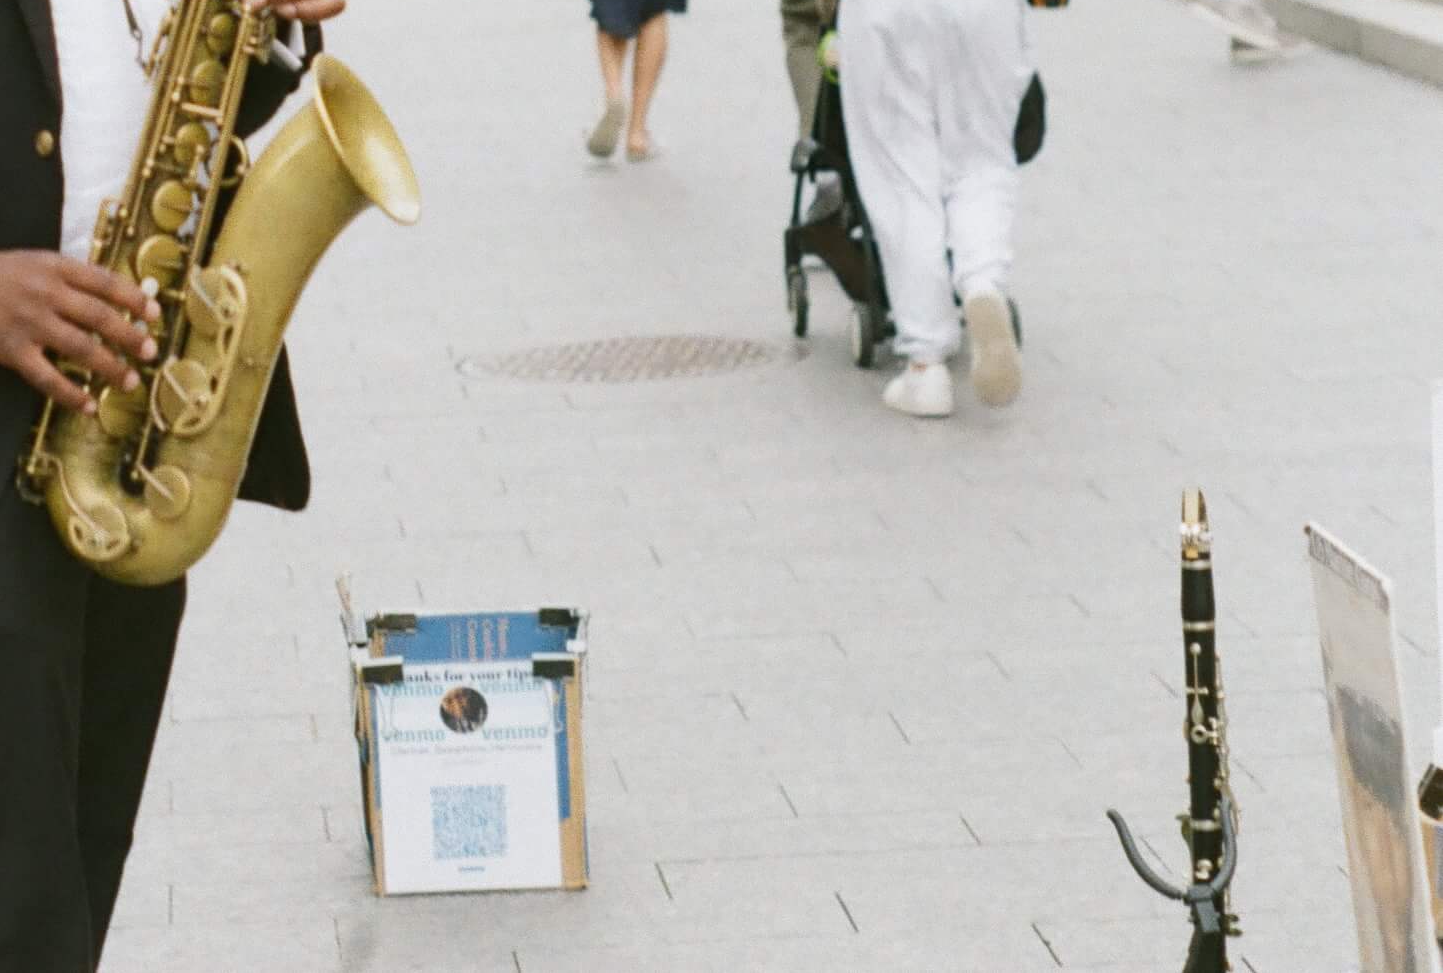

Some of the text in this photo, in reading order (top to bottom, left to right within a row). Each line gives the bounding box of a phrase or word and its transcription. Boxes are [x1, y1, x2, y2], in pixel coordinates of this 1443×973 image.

[405, 670, 441, 683] anks
[444, 669, 463, 682] for
[469, 671, 501, 684] your
[382, 728, 446, 743] venmo
[482, 725, 547, 741] venmo
